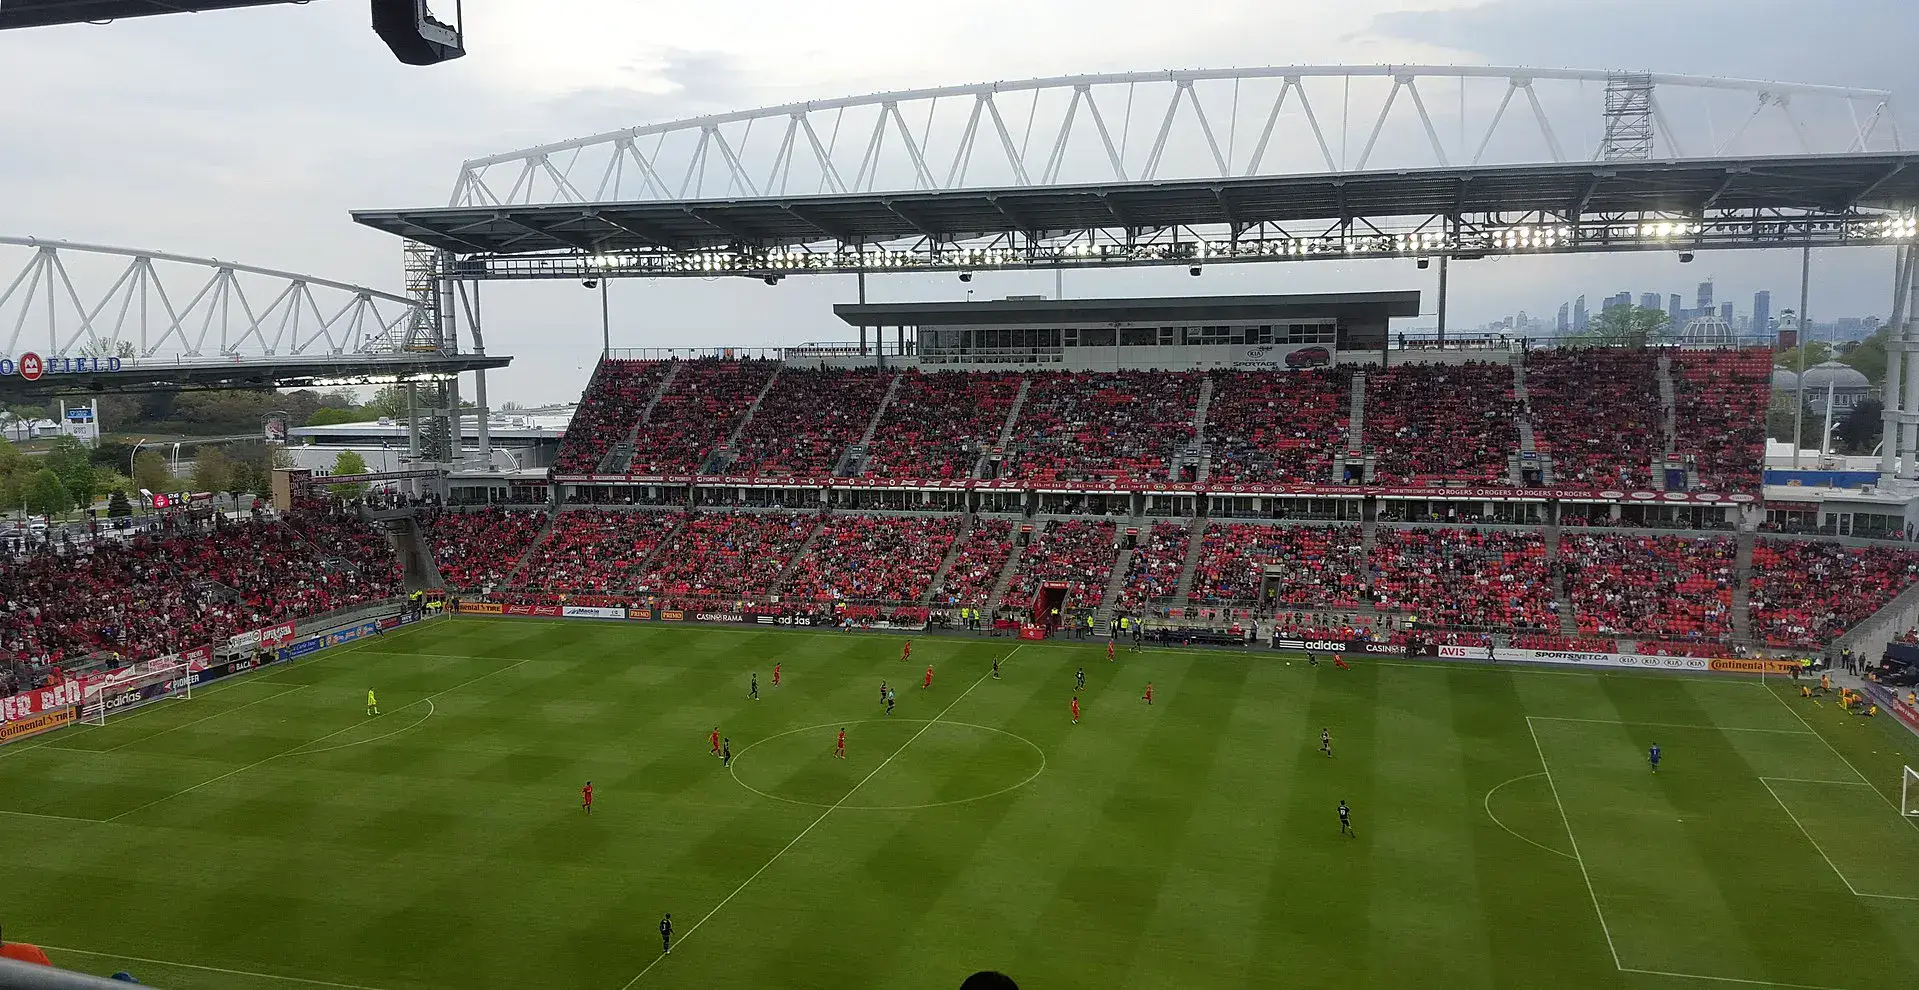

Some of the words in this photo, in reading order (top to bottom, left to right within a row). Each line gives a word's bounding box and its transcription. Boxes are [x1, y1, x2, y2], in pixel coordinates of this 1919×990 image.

[48, 358, 120, 372] FIELD
[778, 616, 810, 625] addas
[1305, 640, 1345, 650] adidas
[1440, 648, 1466, 656] AVIS
[1711, 660, 1766, 670] Continental
[106, 692, 140, 709] adidas
[55, 711, 74, 722] TIRE
